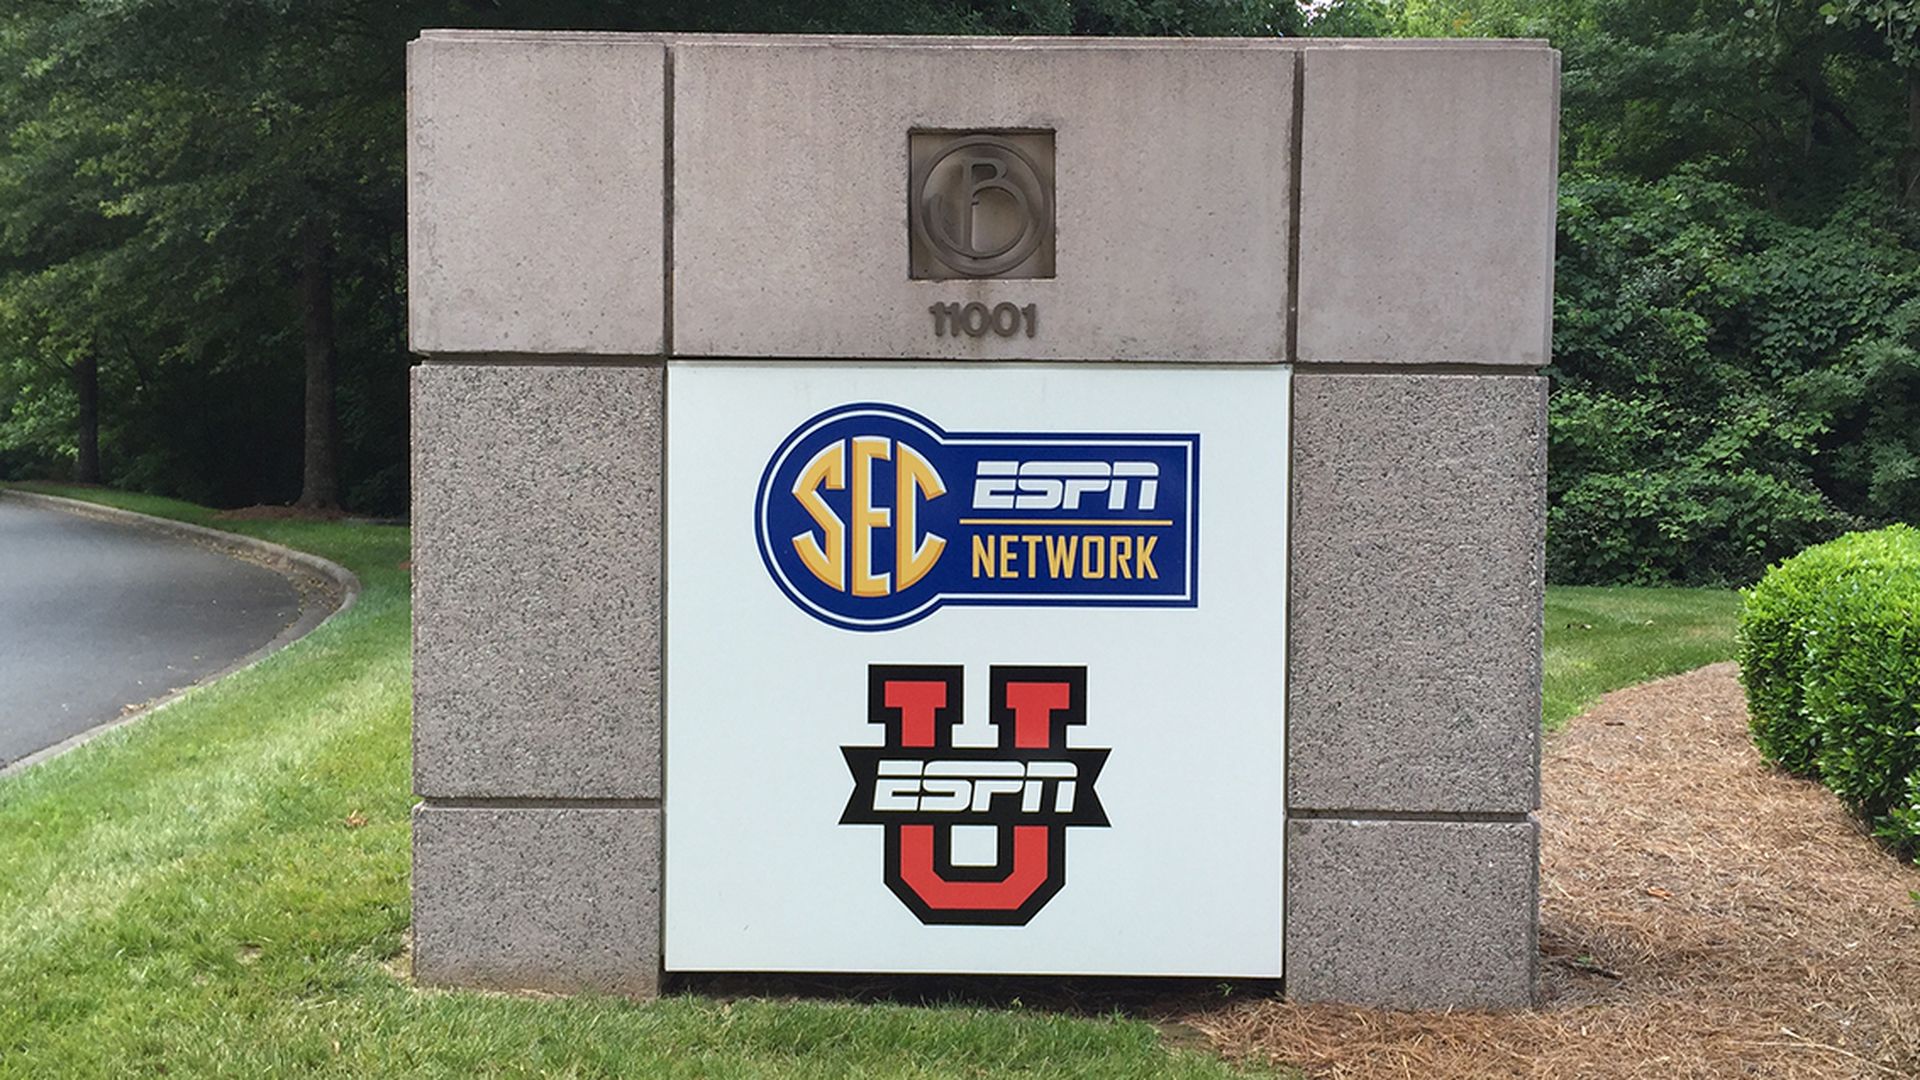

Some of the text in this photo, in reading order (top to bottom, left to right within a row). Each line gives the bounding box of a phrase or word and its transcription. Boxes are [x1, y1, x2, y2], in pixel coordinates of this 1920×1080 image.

[929, 301, 1037, 338] 11001
[972, 460, 1159, 510] ESPN
[791, 435, 947, 598] SEC
[972, 535, 1159, 579] NETWORK
[867, 664, 1088, 926] U
[872, 760, 1078, 813] ESPN
